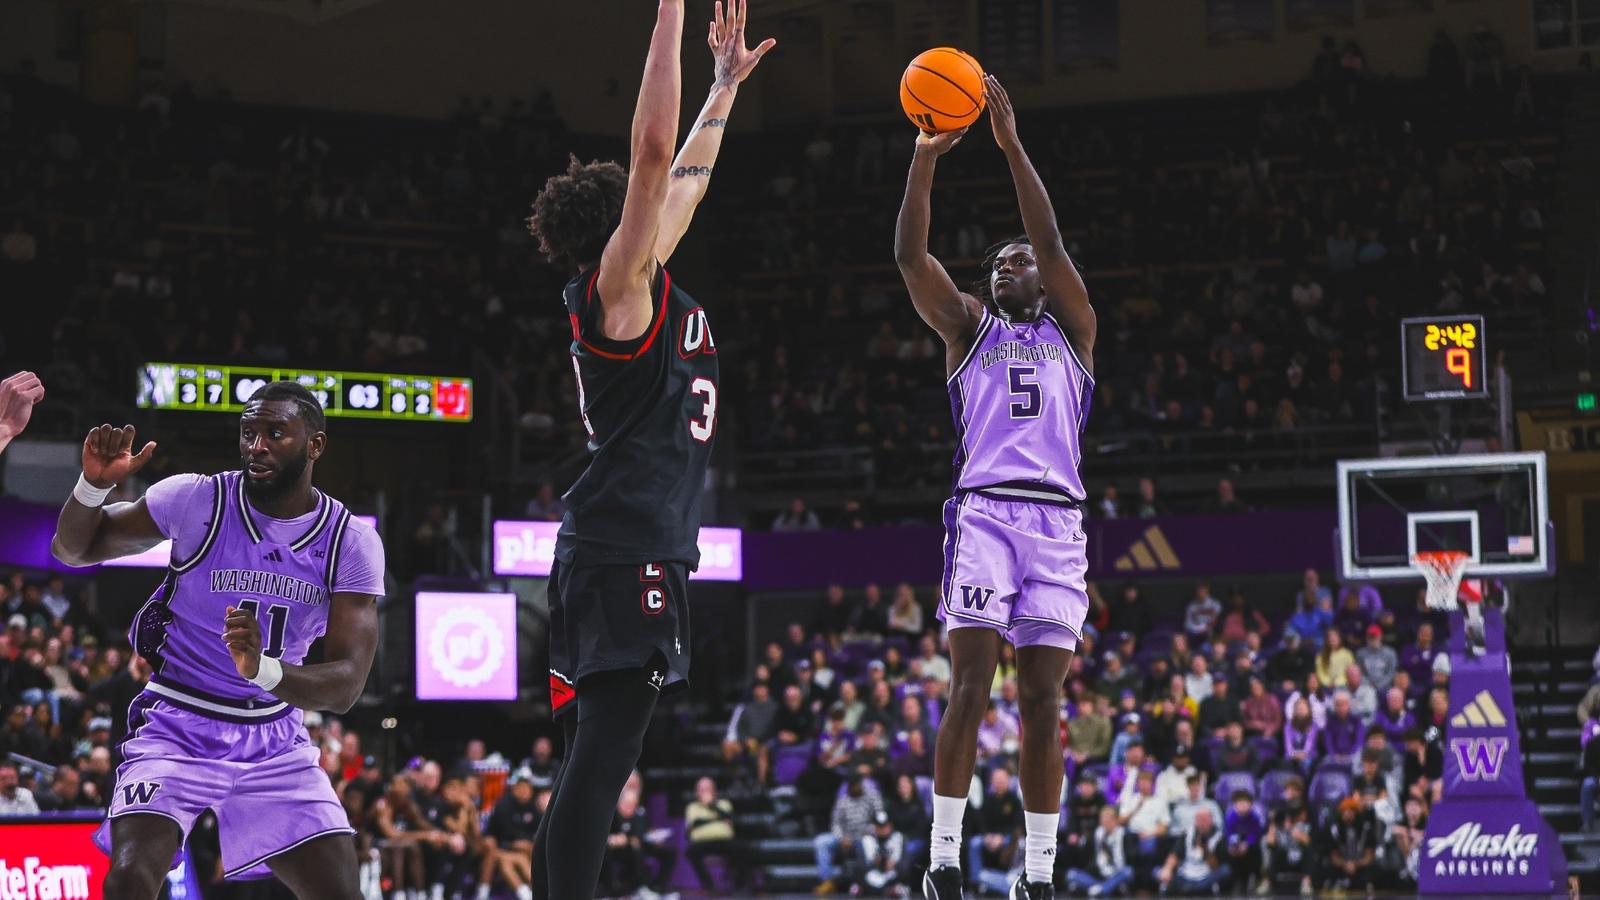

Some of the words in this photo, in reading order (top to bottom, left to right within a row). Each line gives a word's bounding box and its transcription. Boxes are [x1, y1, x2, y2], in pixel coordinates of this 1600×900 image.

[1425, 322, 1477, 350] 2:42
[980, 340, 1063, 371] WASHINGTON
[1446, 348, 1471, 388] 9
[1008, 364, 1043, 419] 5
[497, 528, 555, 570] pla
[210, 569, 327, 606] WASHINGTON
[960, 584, 995, 612] W
[1451, 737, 1509, 782] W
[122, 781, 160, 807] W
[1428, 822, 1538, 860] Alaska
[0, 857, 89, 900] teFarm
[1435, 860, 1530, 877] AIRLINES
